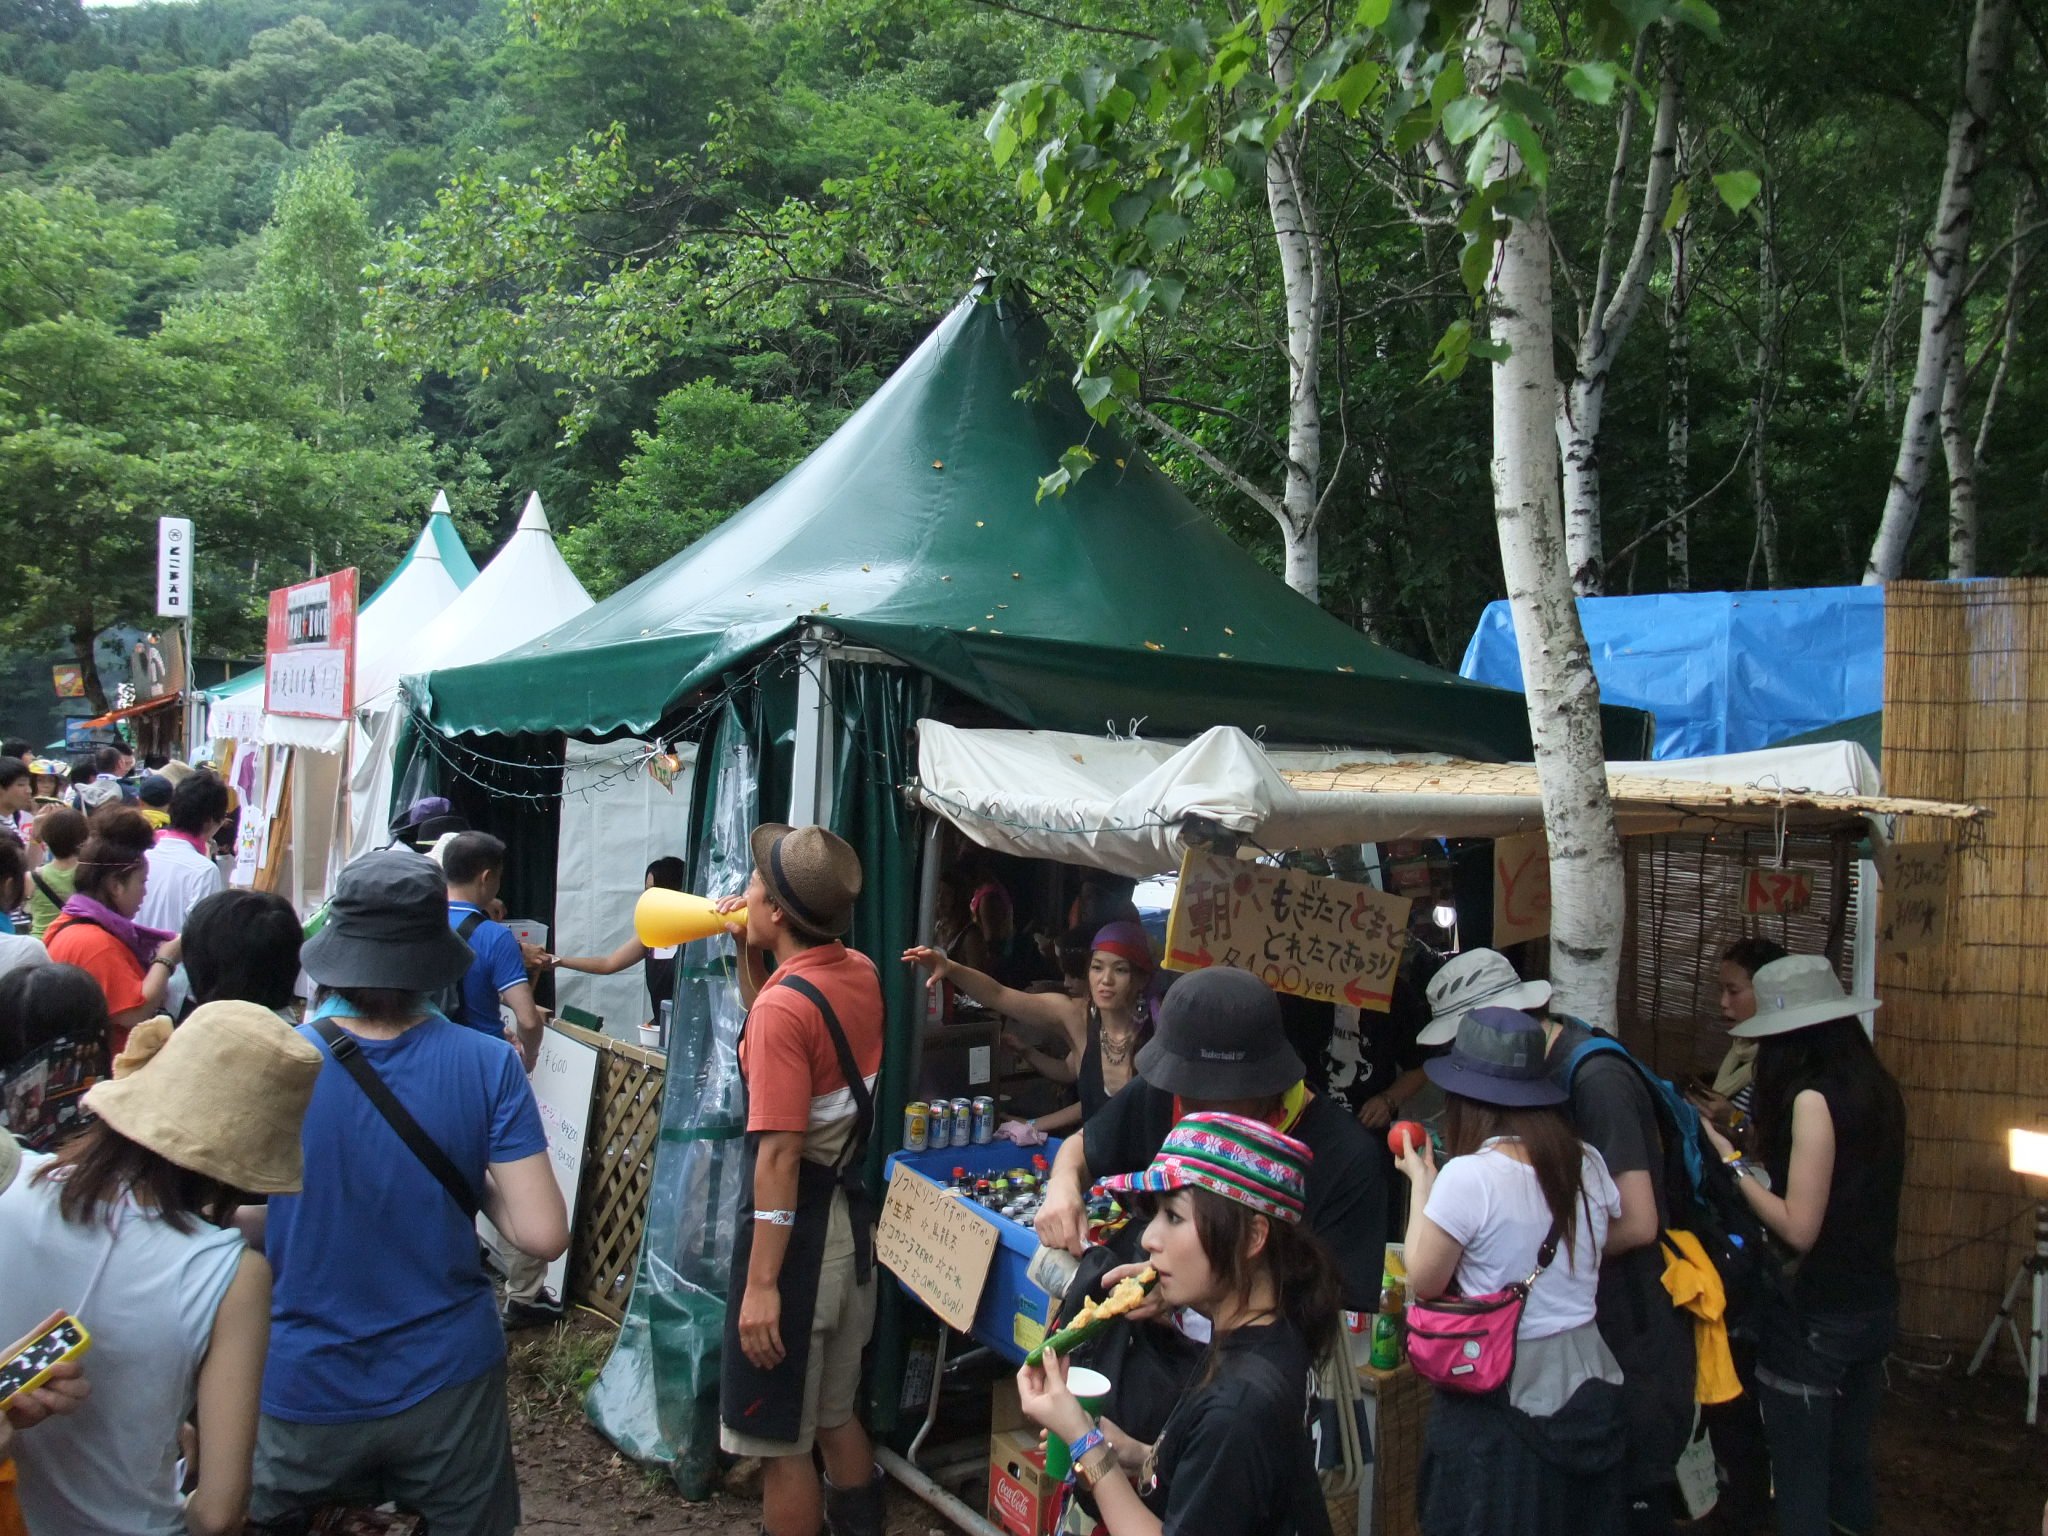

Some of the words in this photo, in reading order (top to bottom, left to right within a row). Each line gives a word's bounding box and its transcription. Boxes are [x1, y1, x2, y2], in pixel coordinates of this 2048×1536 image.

[1185, 880, 1232, 947] 朝
[1270, 877, 1404, 951] もぎたてとまと
[1263, 925, 1395, 981] とれたてきゅうり
[1304, 976, 1336, 998] yen
